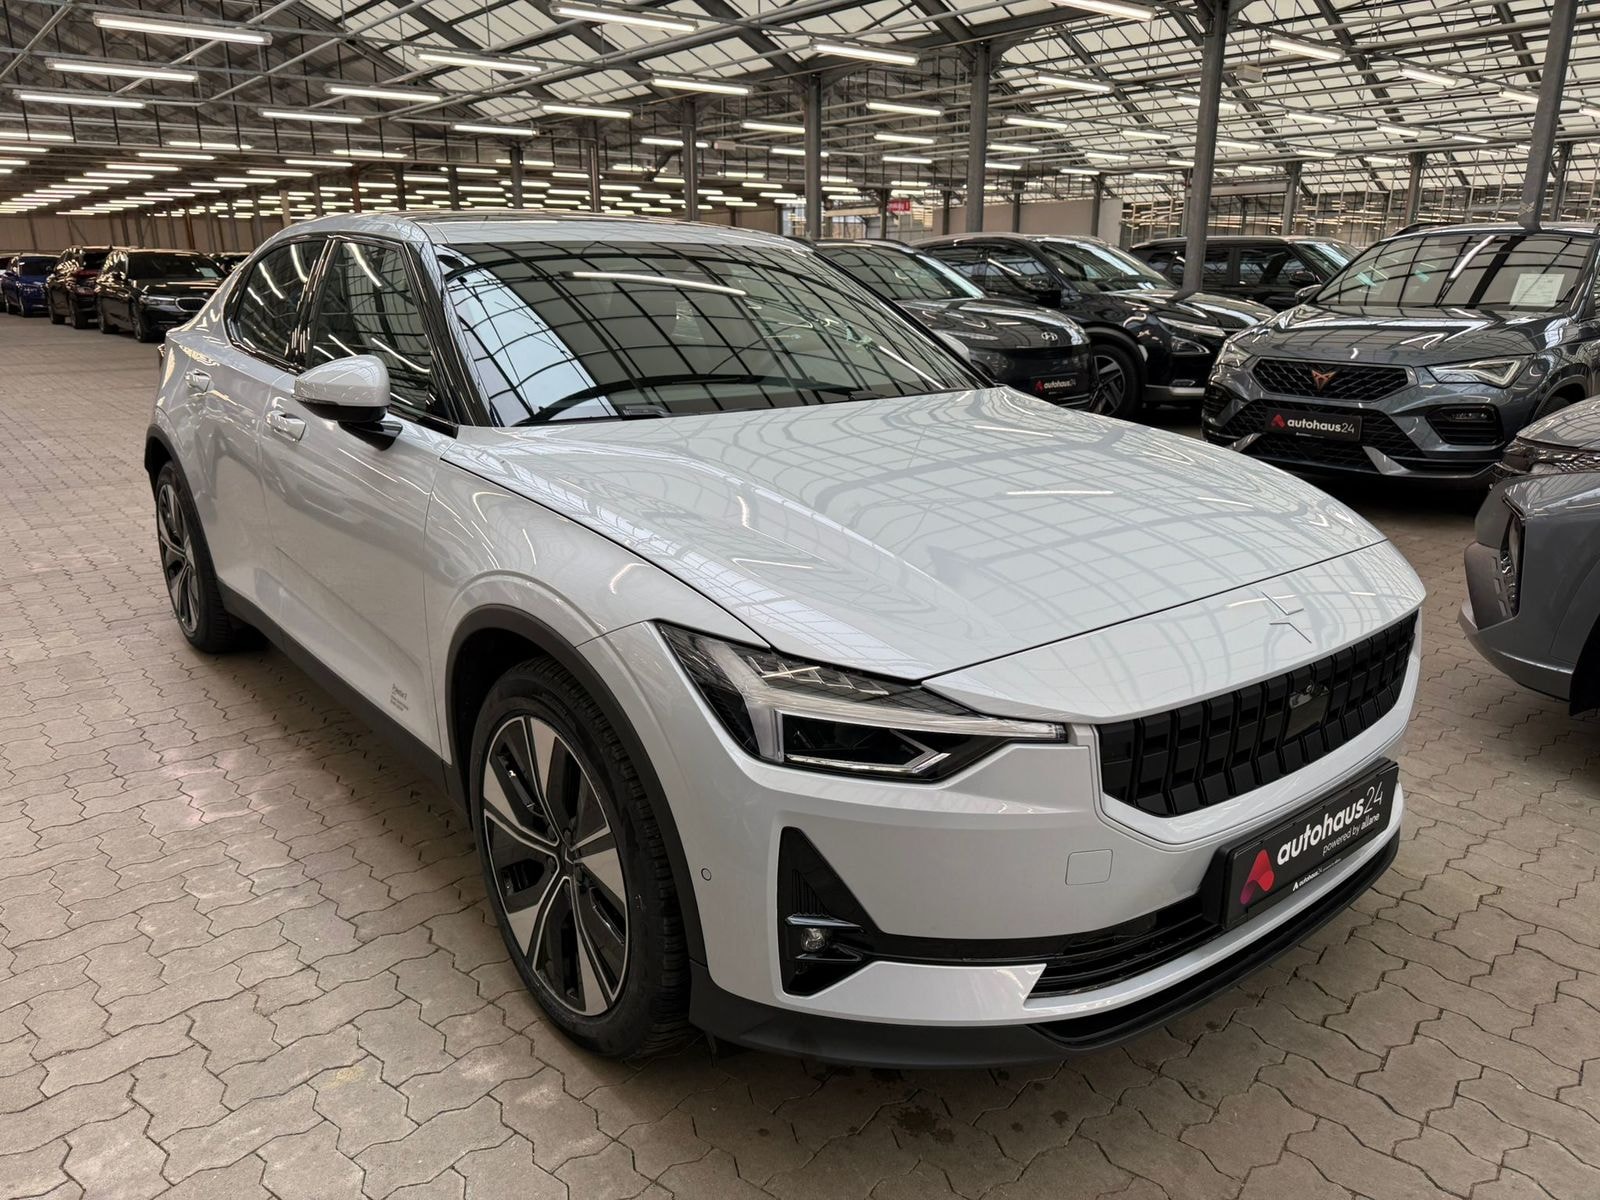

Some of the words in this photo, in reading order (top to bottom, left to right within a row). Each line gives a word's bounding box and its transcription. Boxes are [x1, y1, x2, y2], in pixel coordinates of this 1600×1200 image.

[1287, 418, 1355, 434] autohaus24
[1277, 781, 1384, 865] autohaus24
[1322, 830, 1351, 857] powered
[1352, 824, 1361, 837] by
[1361, 812, 1380, 830] allane
